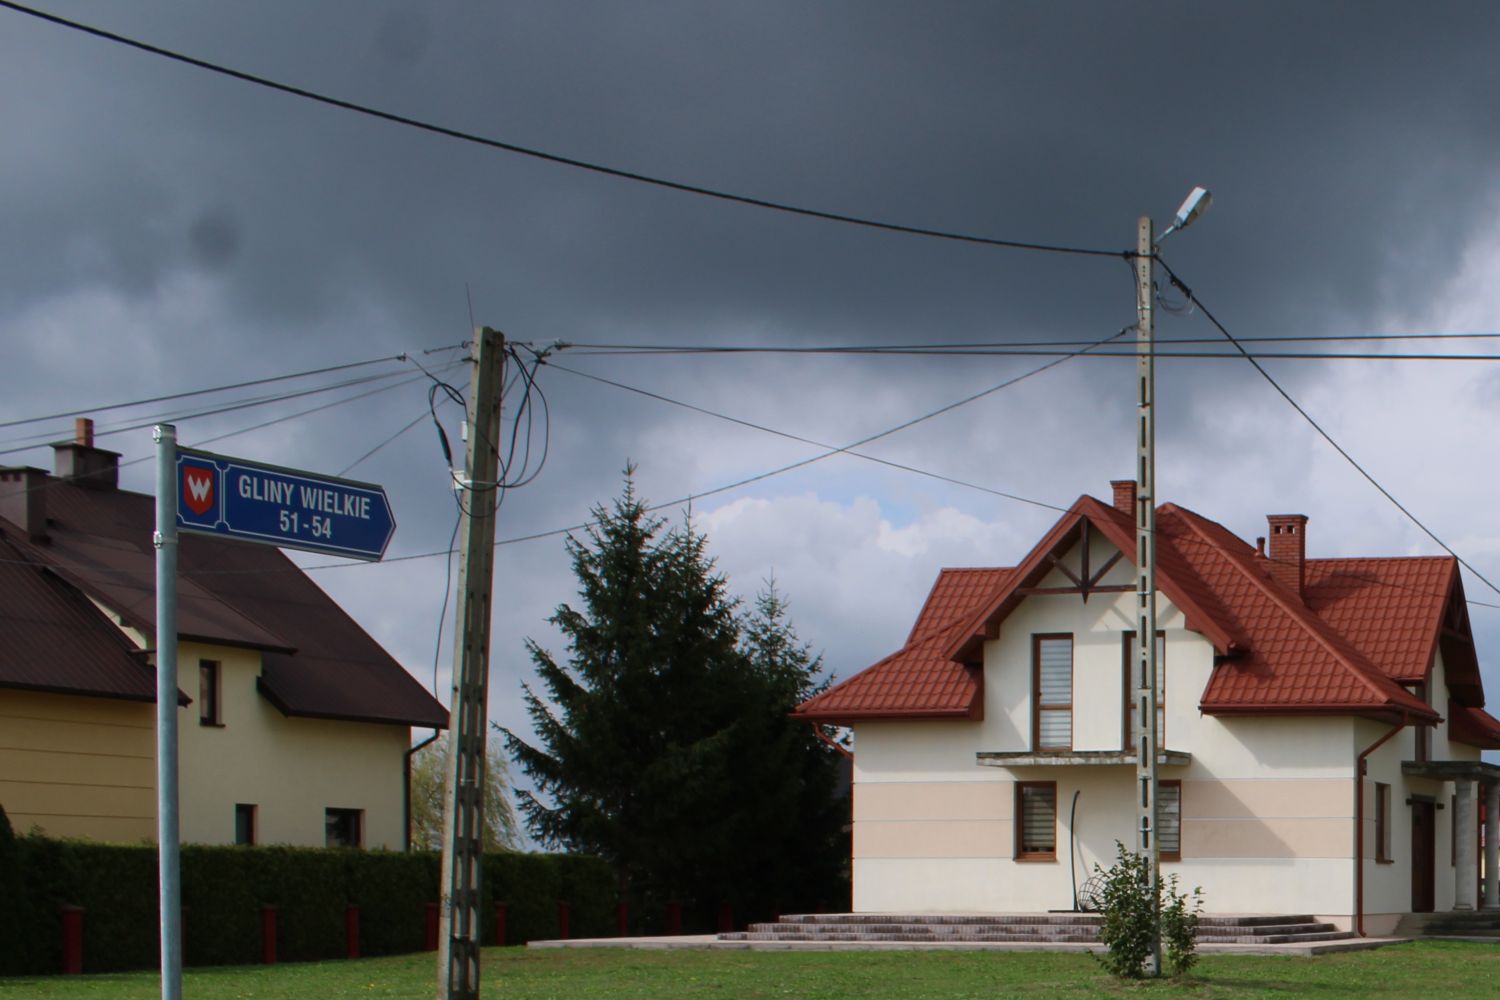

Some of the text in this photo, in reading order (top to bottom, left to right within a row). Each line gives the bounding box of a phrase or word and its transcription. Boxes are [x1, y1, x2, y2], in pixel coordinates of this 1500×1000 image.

[187, 474, 211, 502] W
[238, 475, 370, 519] GLINY WIELKIE
